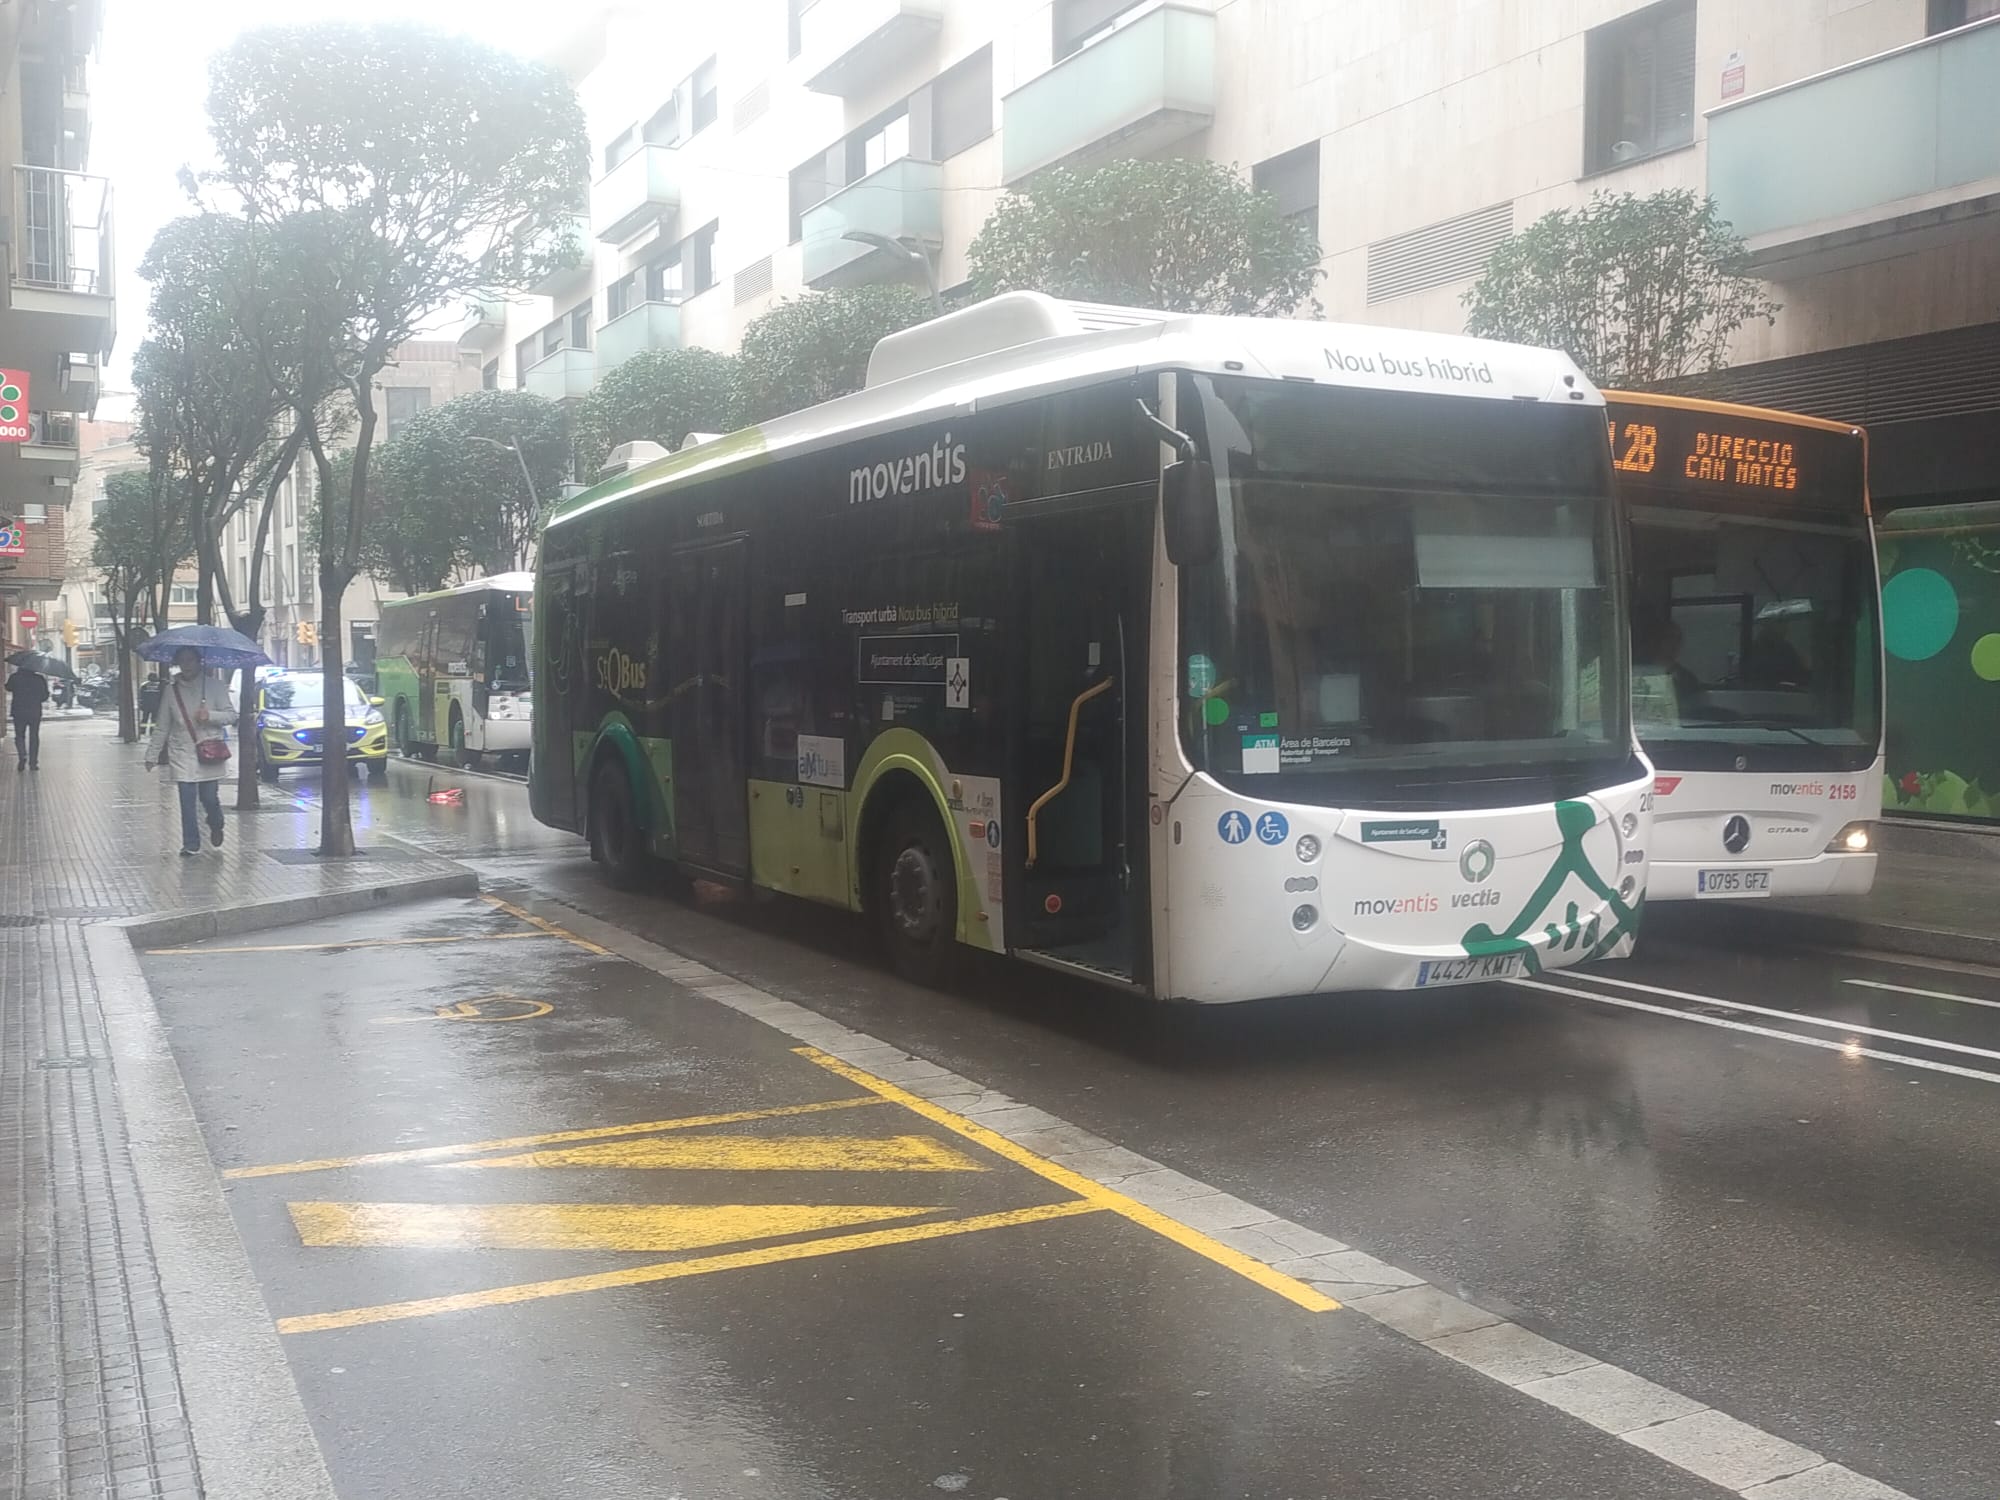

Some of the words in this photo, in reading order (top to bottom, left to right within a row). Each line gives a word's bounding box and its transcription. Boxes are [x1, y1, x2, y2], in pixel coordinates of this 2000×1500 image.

[1323, 347, 1376, 374] Nou
[1378, 352, 1424, 377] bus
[1425, 356, 1494, 384] híbrid
[1048, 440, 1112, 470] ENTRADA
[849, 432, 967, 504] moventis
[1685, 455, 1727, 481] CAN
[1735, 461, 1797, 489] MATES
[841, 607, 877, 627] Transport
[1254, 739, 1276, 749] ATM
[1301, 737, 1311, 747] de
[1313, 737, 1351, 747] Barcelona
[1770, 780, 1823, 796] moventis
[1828, 784, 1857, 800] 2158
[1767, 826, 1809, 834] CITARO
[1708, 873, 1739, 890] 0795
[1744, 872, 1769, 889] GFZ
[1354, 893, 1438, 916] moventis
[1451, 889, 1501, 908] vectia
[1430, 960, 1477, 981] 4427
[1481, 956, 1516, 977] KMT
